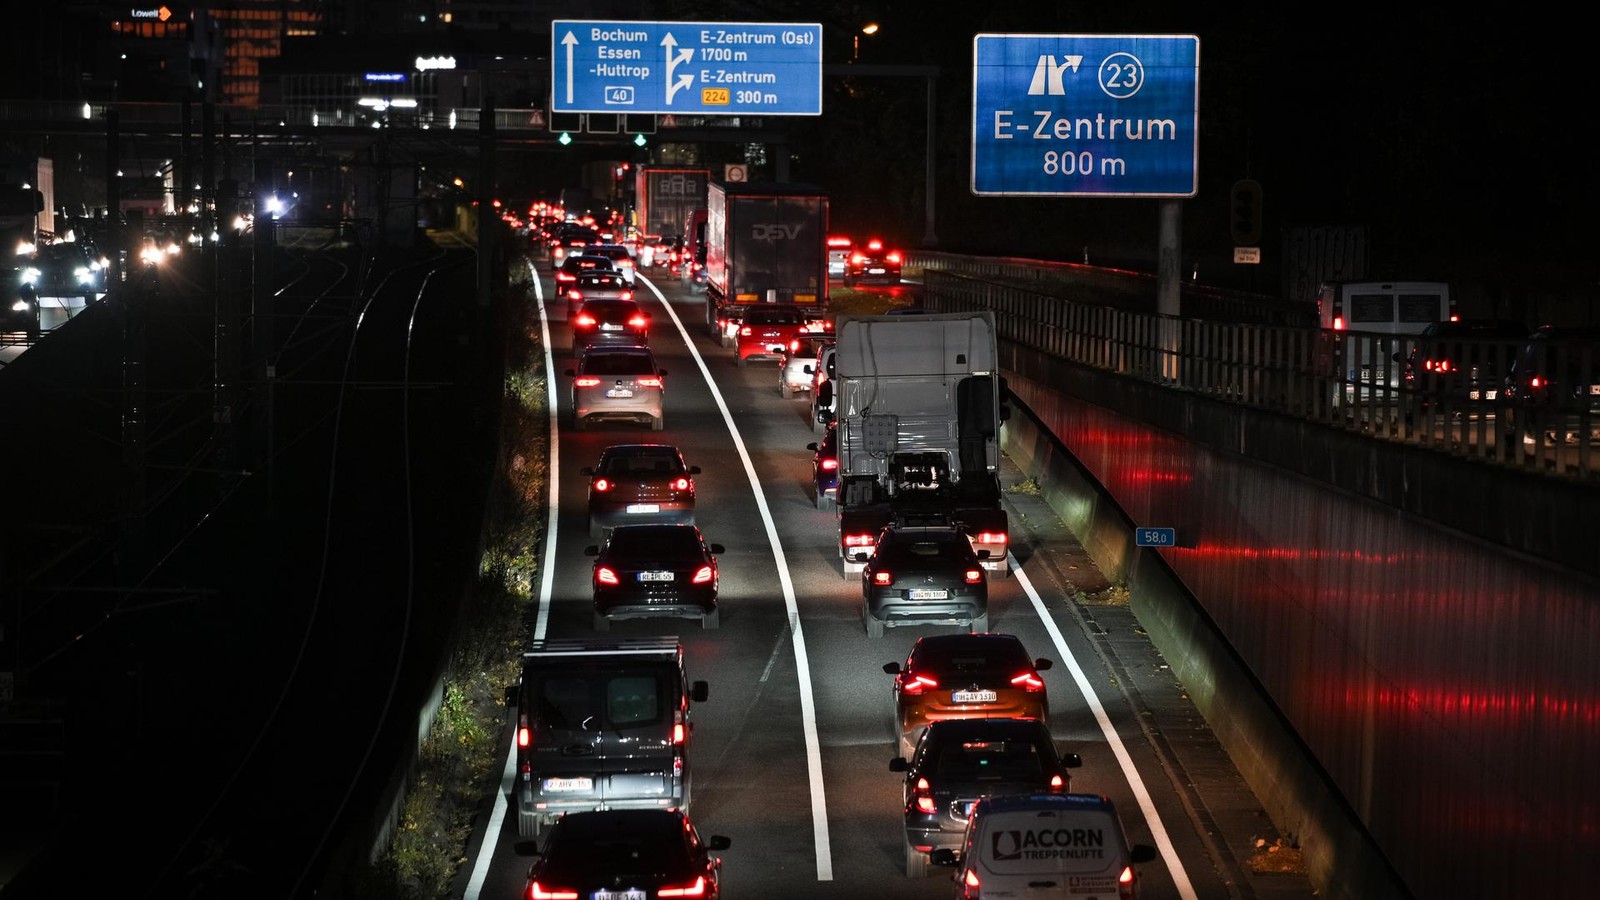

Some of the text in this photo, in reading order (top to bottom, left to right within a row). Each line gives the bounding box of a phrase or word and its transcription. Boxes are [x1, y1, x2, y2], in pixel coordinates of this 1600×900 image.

[131, 9, 158, 18] Lowell
[591, 28, 648, 42] Bochum
[701, 31, 814, 46] E-Zentrum (Ost)
[598, 46, 640, 59] Essen
[702, 48, 747, 62] 1700 m
[590, 64, 650, 80] -Huttrop
[701, 70, 776, 84] E-Zentrum
[1106, 63, 1138, 88] 23
[612, 90, 627, 102] 40
[705, 90, 777, 104] 224 300 m
[994, 110, 1176, 140] E-Zentrum
[1043, 150, 1126, 176] 800 m
[752, 223, 804, 240] DSV
[1145, 532, 1166, 544] 58,0
[1023, 829, 1103, 848] ACORN
[1024, 850, 1104, 860] TREPPENLIFTE
